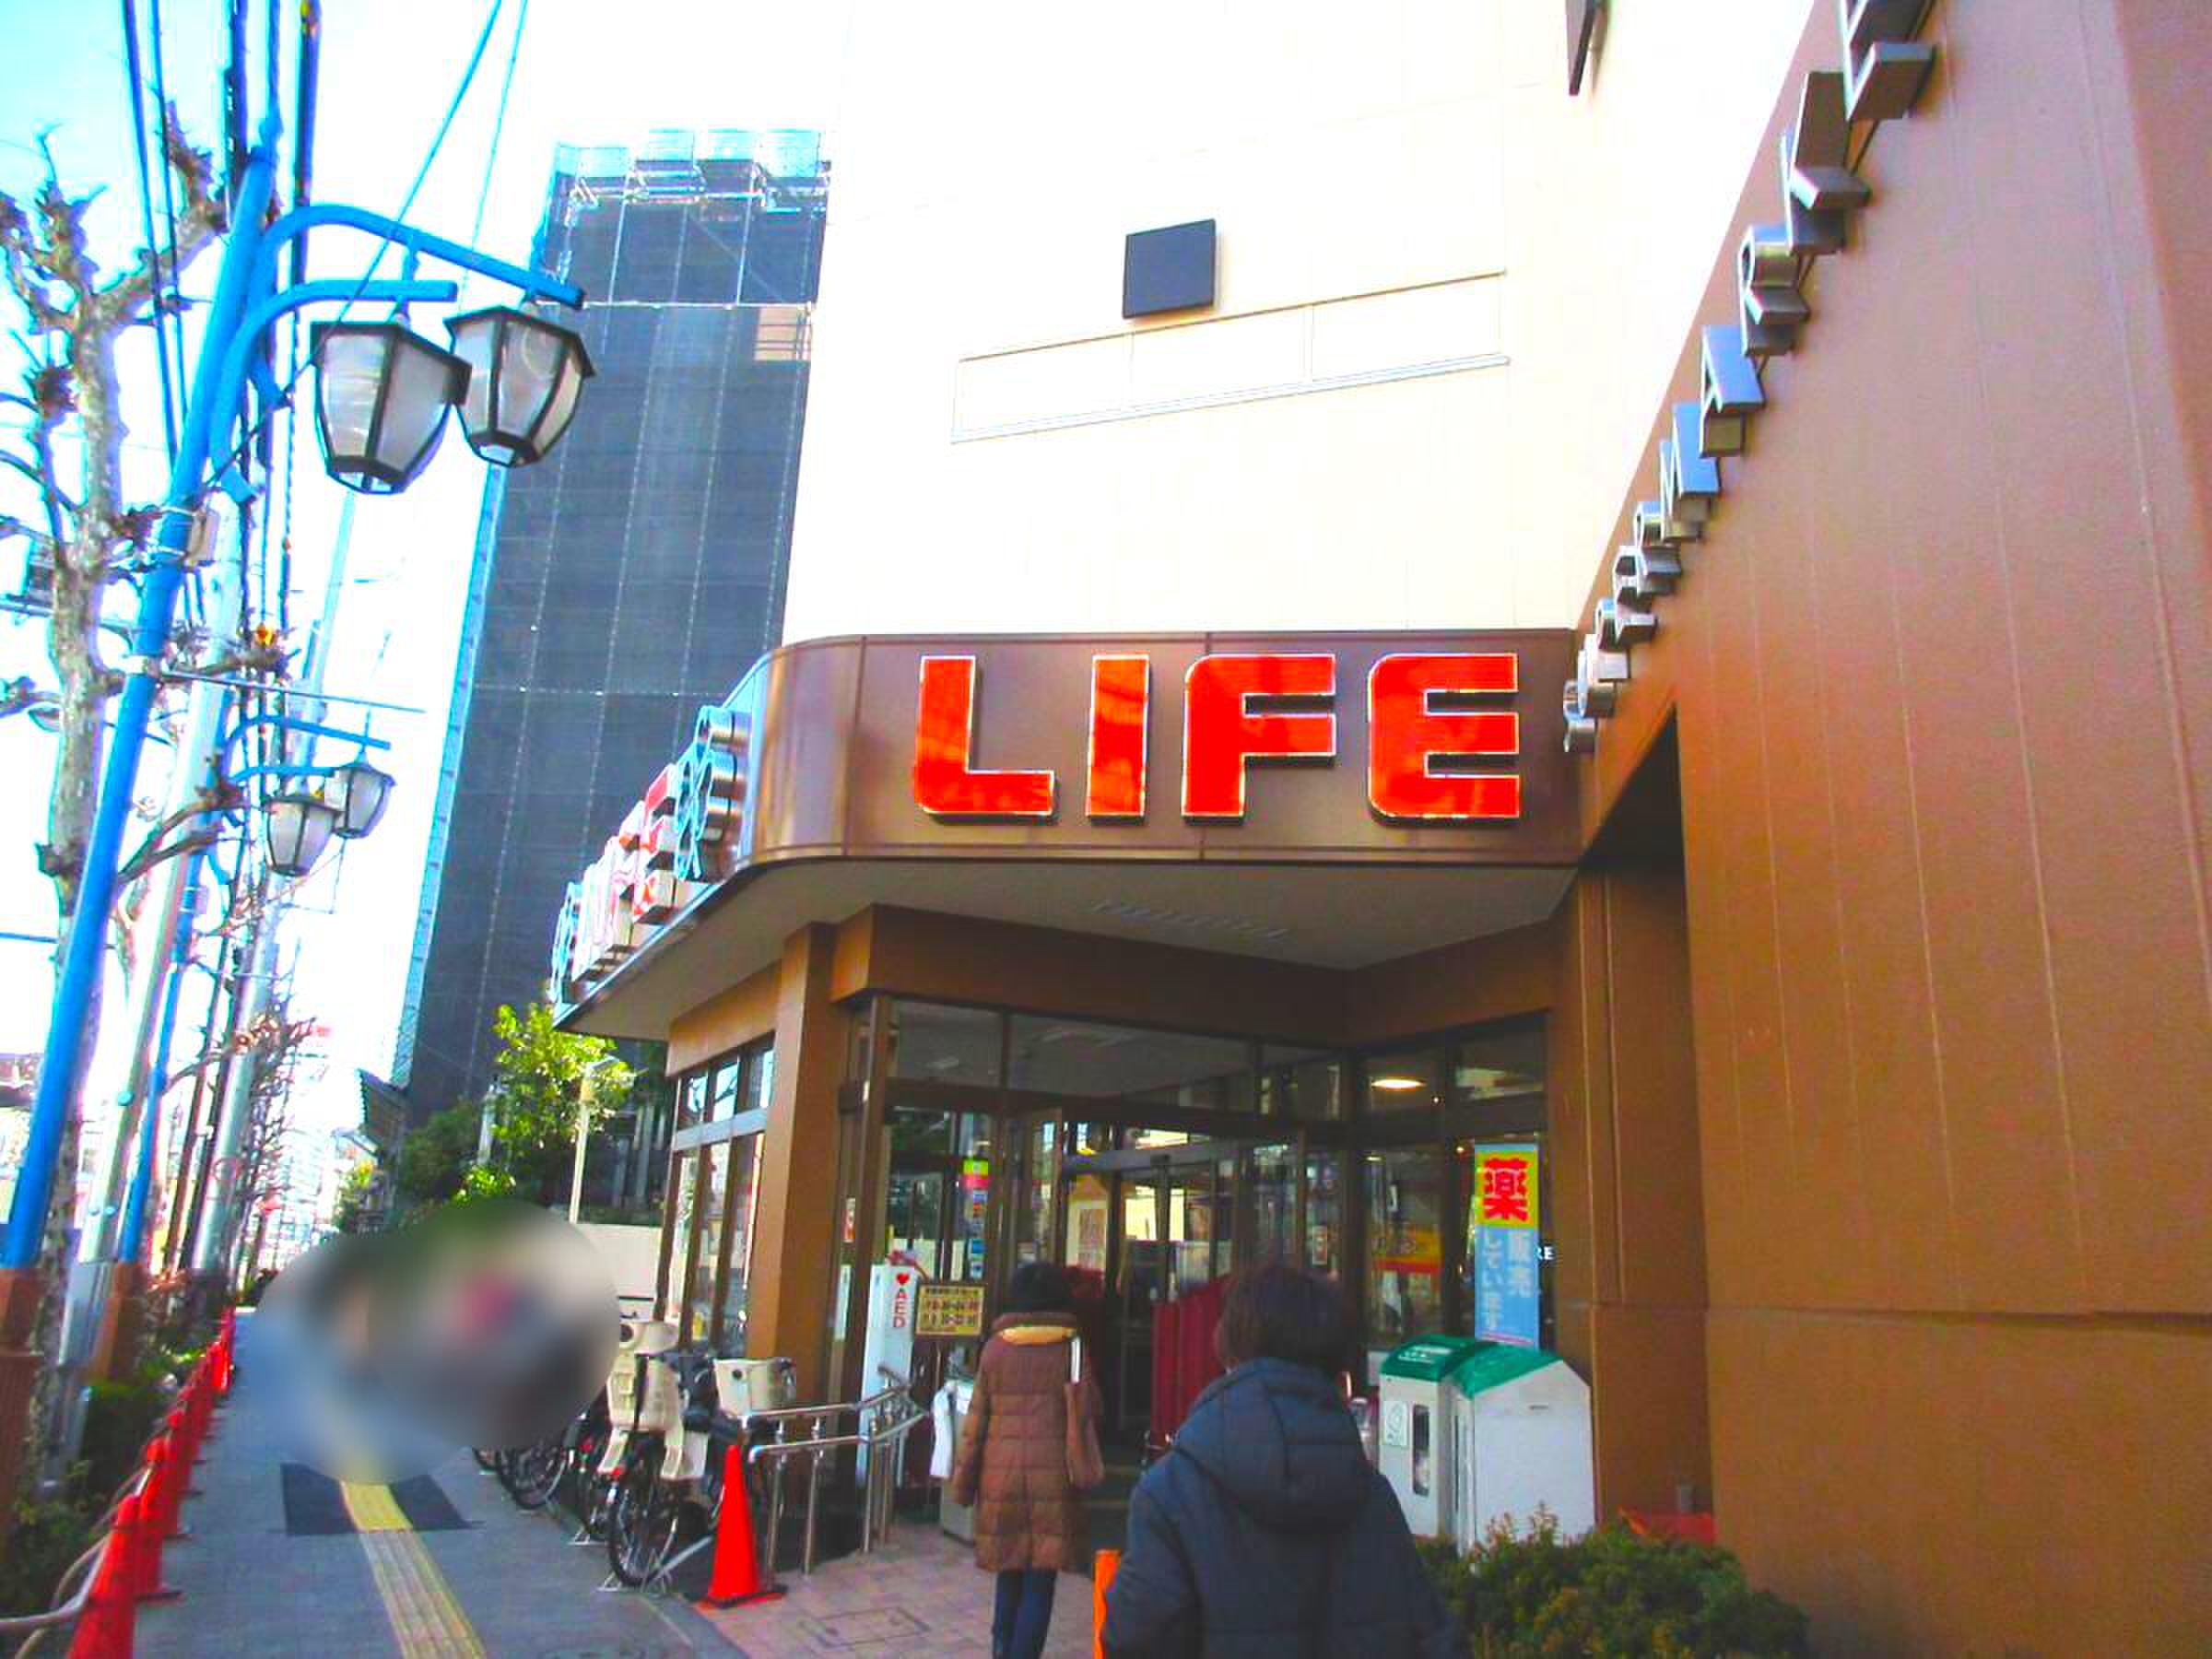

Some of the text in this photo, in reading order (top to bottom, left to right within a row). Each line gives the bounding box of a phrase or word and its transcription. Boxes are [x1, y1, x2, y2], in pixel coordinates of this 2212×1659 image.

[913, 653, 1520, 818] LIFE
[1483, 1158, 1528, 1222] 薬
[1480, 1230, 1503, 1329] しています
[1508, 1229, 1532, 1299] 販売
[892, 1287, 909, 1328] AED
